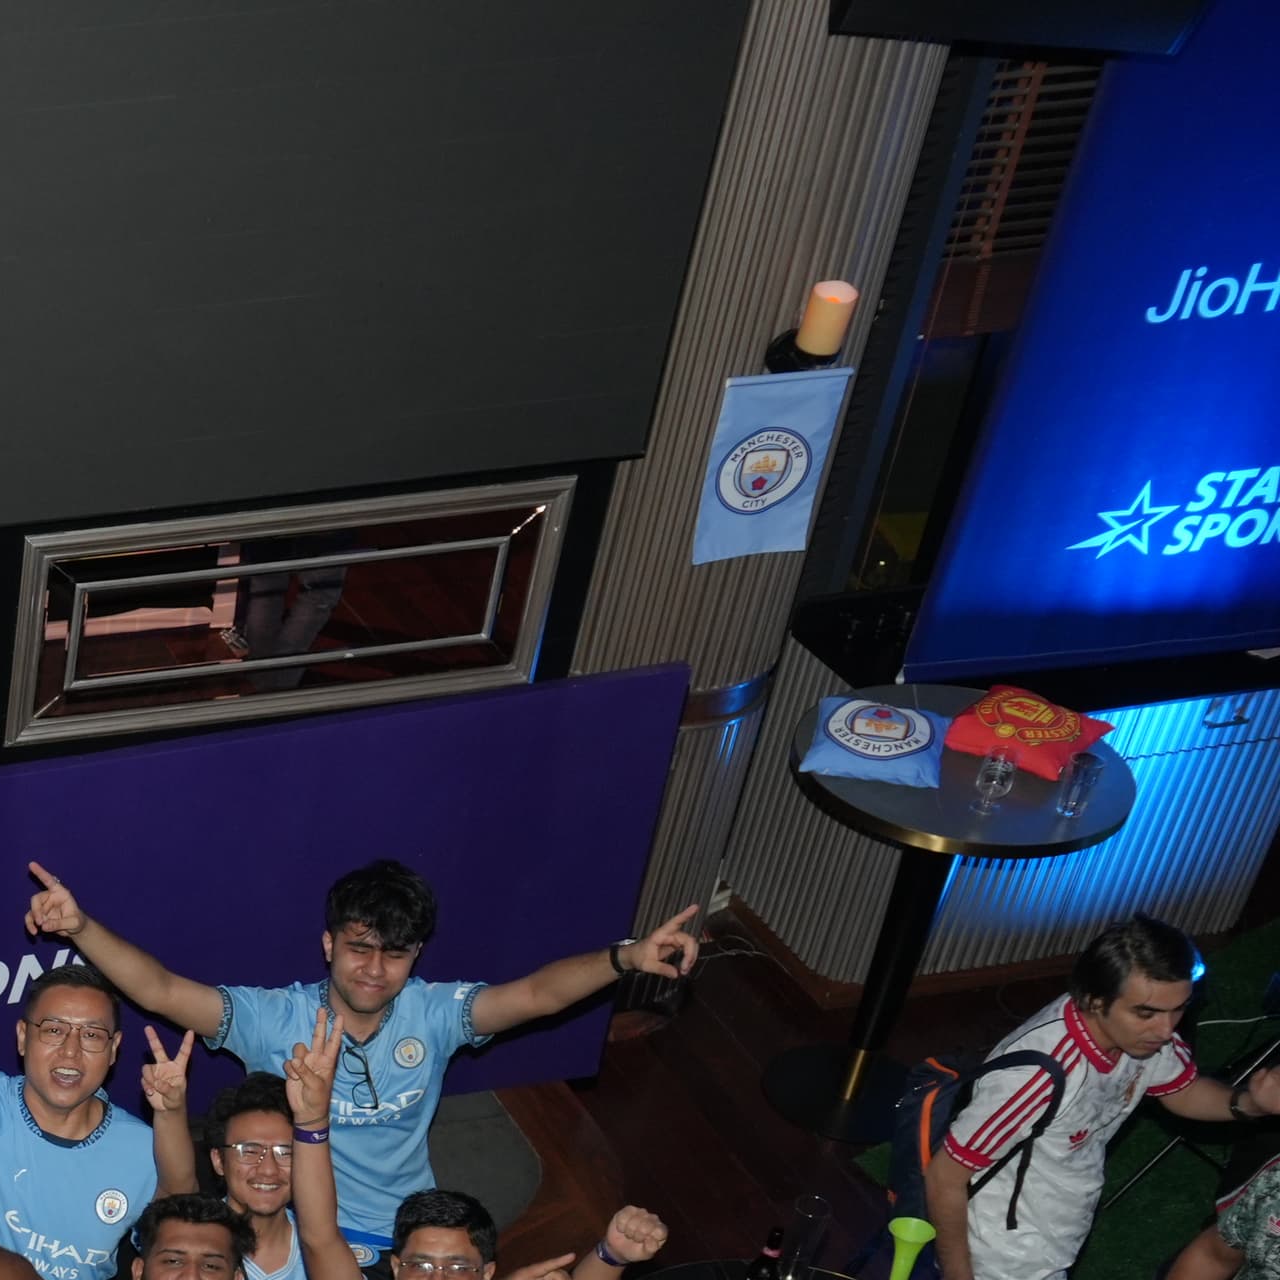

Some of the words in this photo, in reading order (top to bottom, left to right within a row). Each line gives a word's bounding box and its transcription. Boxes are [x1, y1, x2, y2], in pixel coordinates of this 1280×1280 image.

[731, 433, 803, 463] MANCHESTER
[742, 497, 768, 509] CITY
[33, 1256, 79, 1280] WAYS
